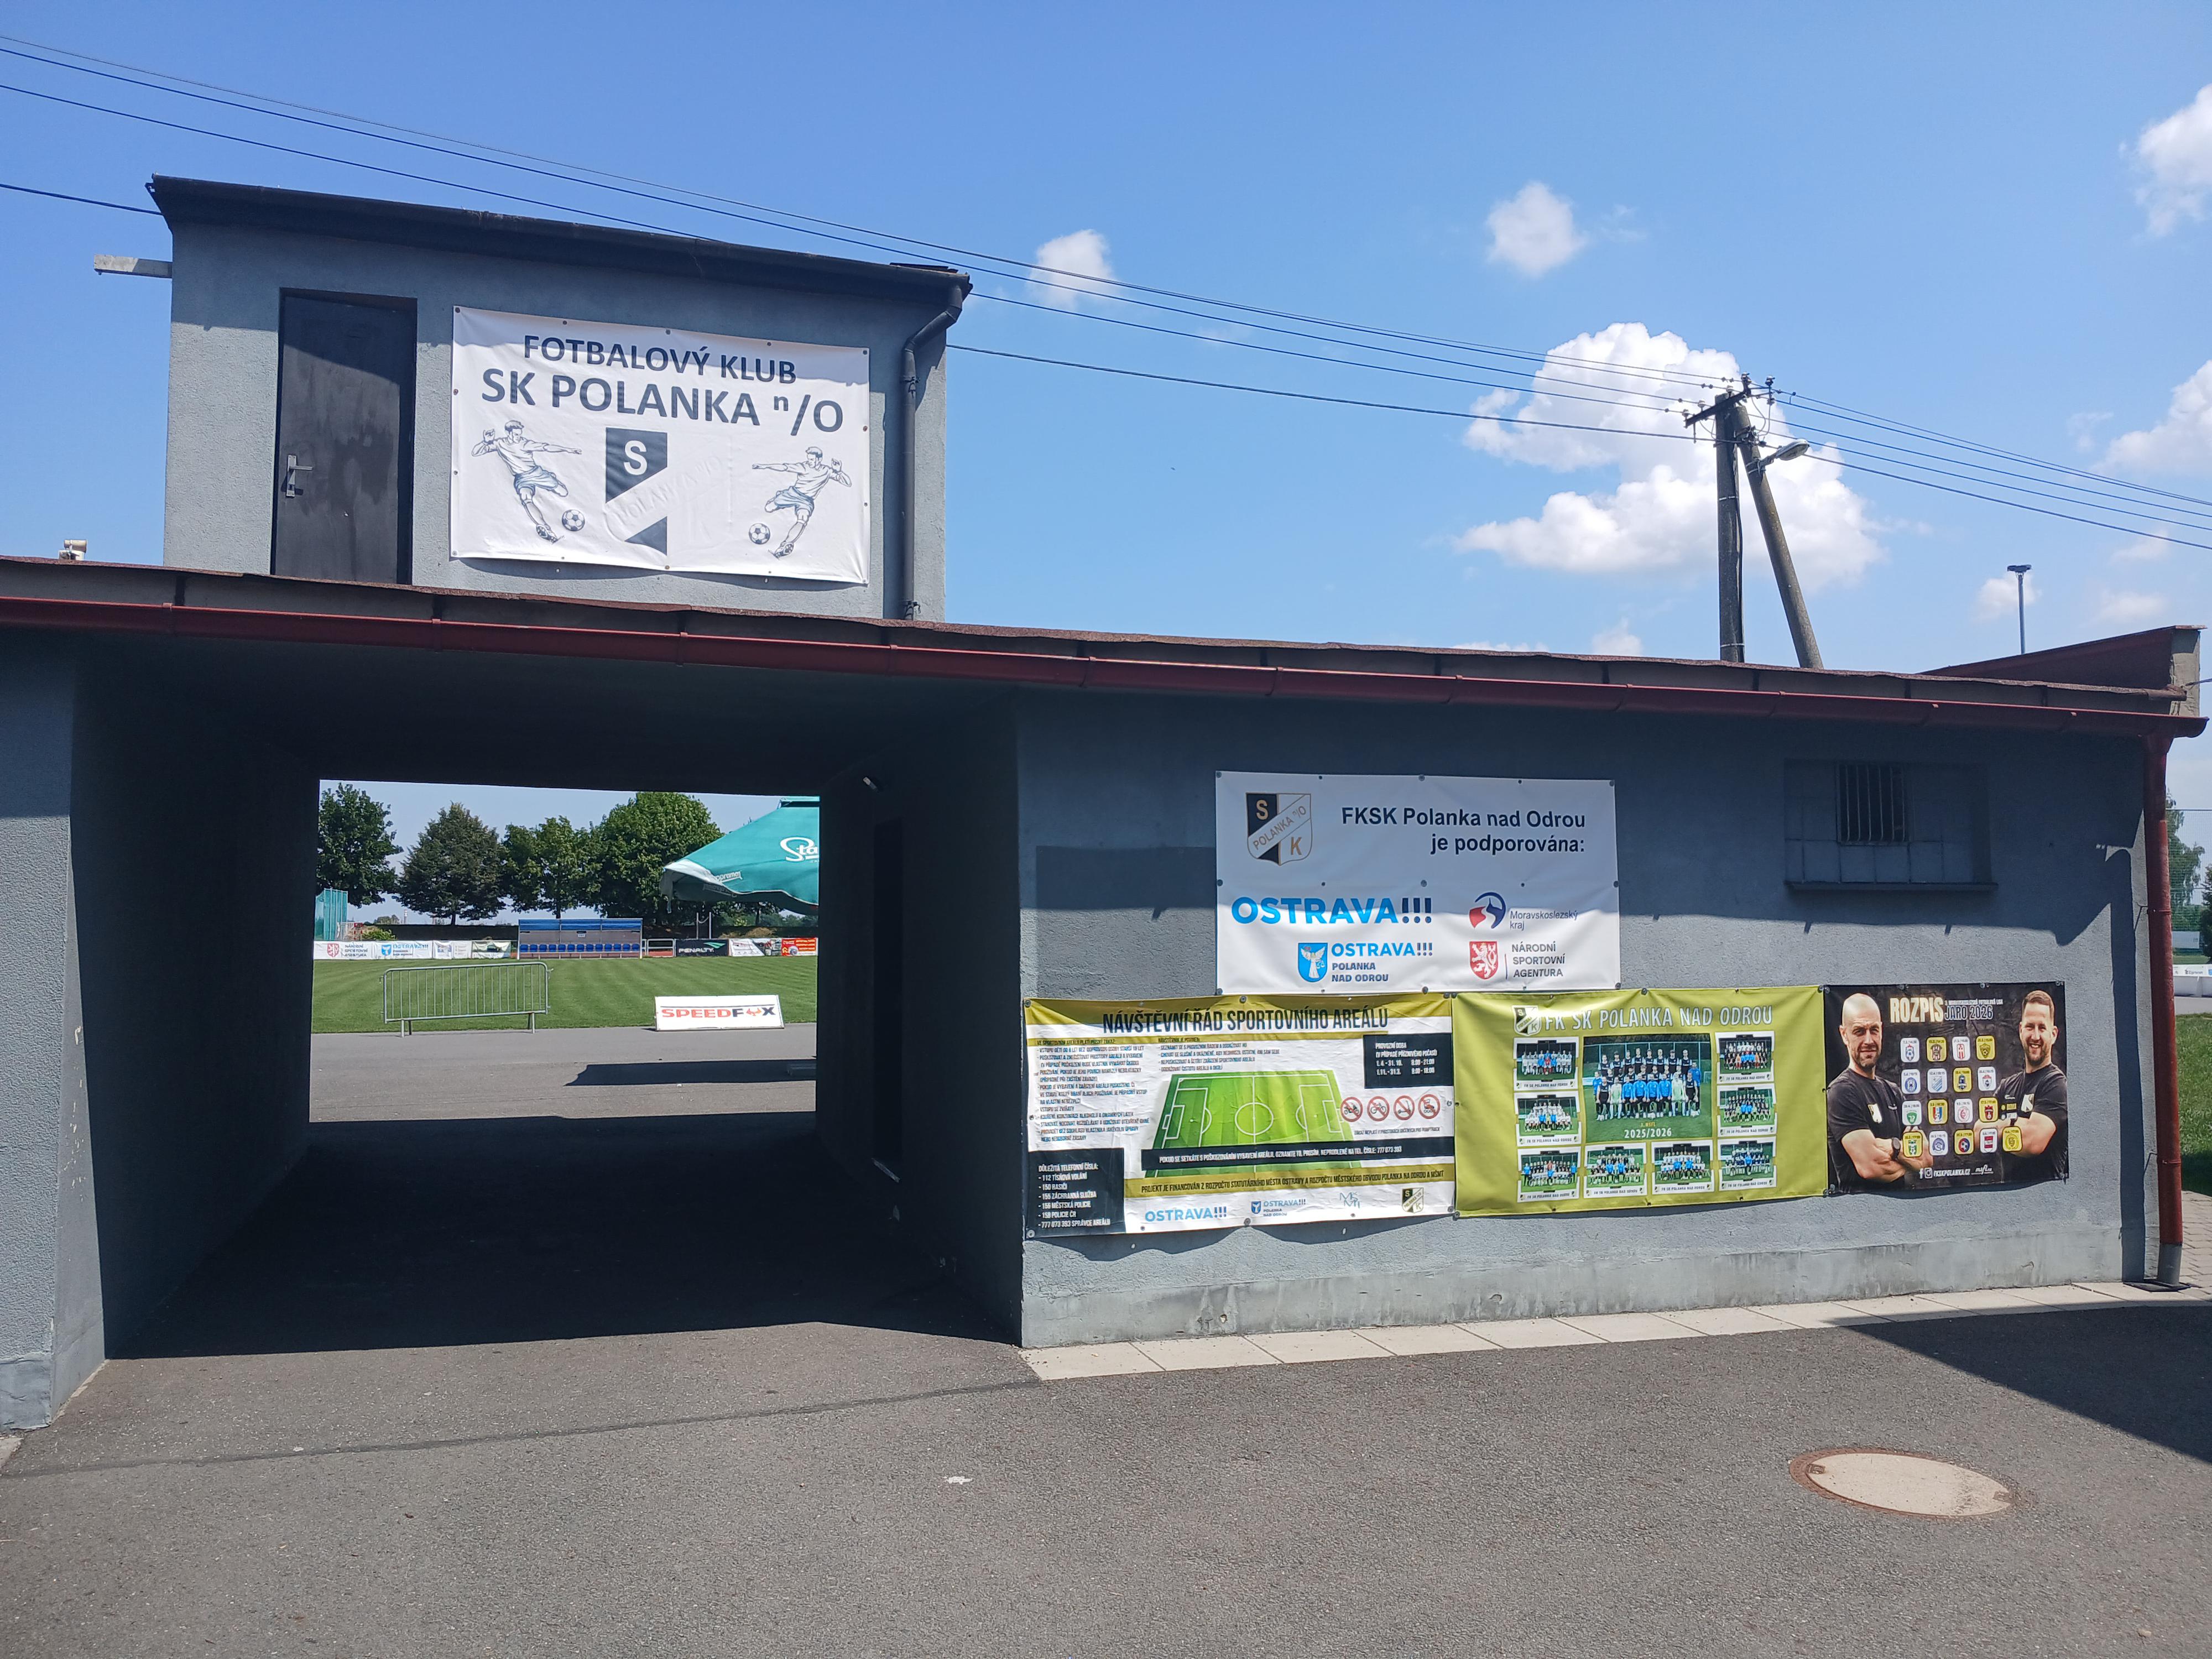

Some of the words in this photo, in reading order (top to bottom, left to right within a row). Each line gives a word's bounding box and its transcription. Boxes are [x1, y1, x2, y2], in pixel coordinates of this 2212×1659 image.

[524, 335, 710, 375] FOTBALOVÝ
[720, 355, 796, 384] KLUB
[482, 368, 536, 405] SK
[552, 375, 760, 426] POLANKA
[623, 440, 648, 475] S
[1256, 800, 1268, 820] S
[1342, 807, 1397, 825] FKSK
[1404, 808, 1481, 827] Polanka
[1488, 811, 1521, 827] nad
[1526, 811, 1585, 828] Odrou
[1253, 817, 1294, 850] POLANKA
[1291, 837, 1302, 855] K
[1430, 834, 1448, 855] je
[1455, 834, 1585, 853] podporována:
[1231, 897, 1432, 925] OSTRAVA!!!
[1510, 910, 1578, 922] Moravskoslezský
[1510, 921, 1524, 931] kraj
[1331, 942, 1433, 957] OSTRAVA!!!
[1511, 942, 1556, 953] NÁRODNÍ
[1332, 962, 1376, 971] POLANKA
[1513, 954, 1565, 966] SPORTOVNÍ
[1332, 973, 1352, 982] NAD
[1355, 973, 1389, 982] ODROU
[1514, 968, 1563, 978] AGENTURA
[1545, 1015, 1566, 1030] FK
[1572, 1009, 1592, 1030] SK
[1600, 1007, 1673, 1028] POLANKA
[1680, 1006, 1713, 1026] NAD
[1719, 1005, 1772, 1025] ODROU
[1890, 998, 1943, 1022] ROZPIS
[1945, 1006, 1968, 1020] JARO
[1969, 1005, 1994, 1020] 2026
[1103, 1009, 1191, 1033] NÁVŠTĚVNÍ
[1193, 1008, 1223, 1031] ŘÁD
[1227, 1006, 1326, 1030] SPORTOVNÍHO
[1333, 1006, 1388, 1029] AREÁLU
[1624, 1128, 1672, 1138] 2025/2026
[1039, 1164, 1060, 1172] DŮLEŽITÁ
[1170, 1182, 1200, 1191] FINANCOVÁN
[1145, 1206, 1227, 1222] OSTRAVA!!!
